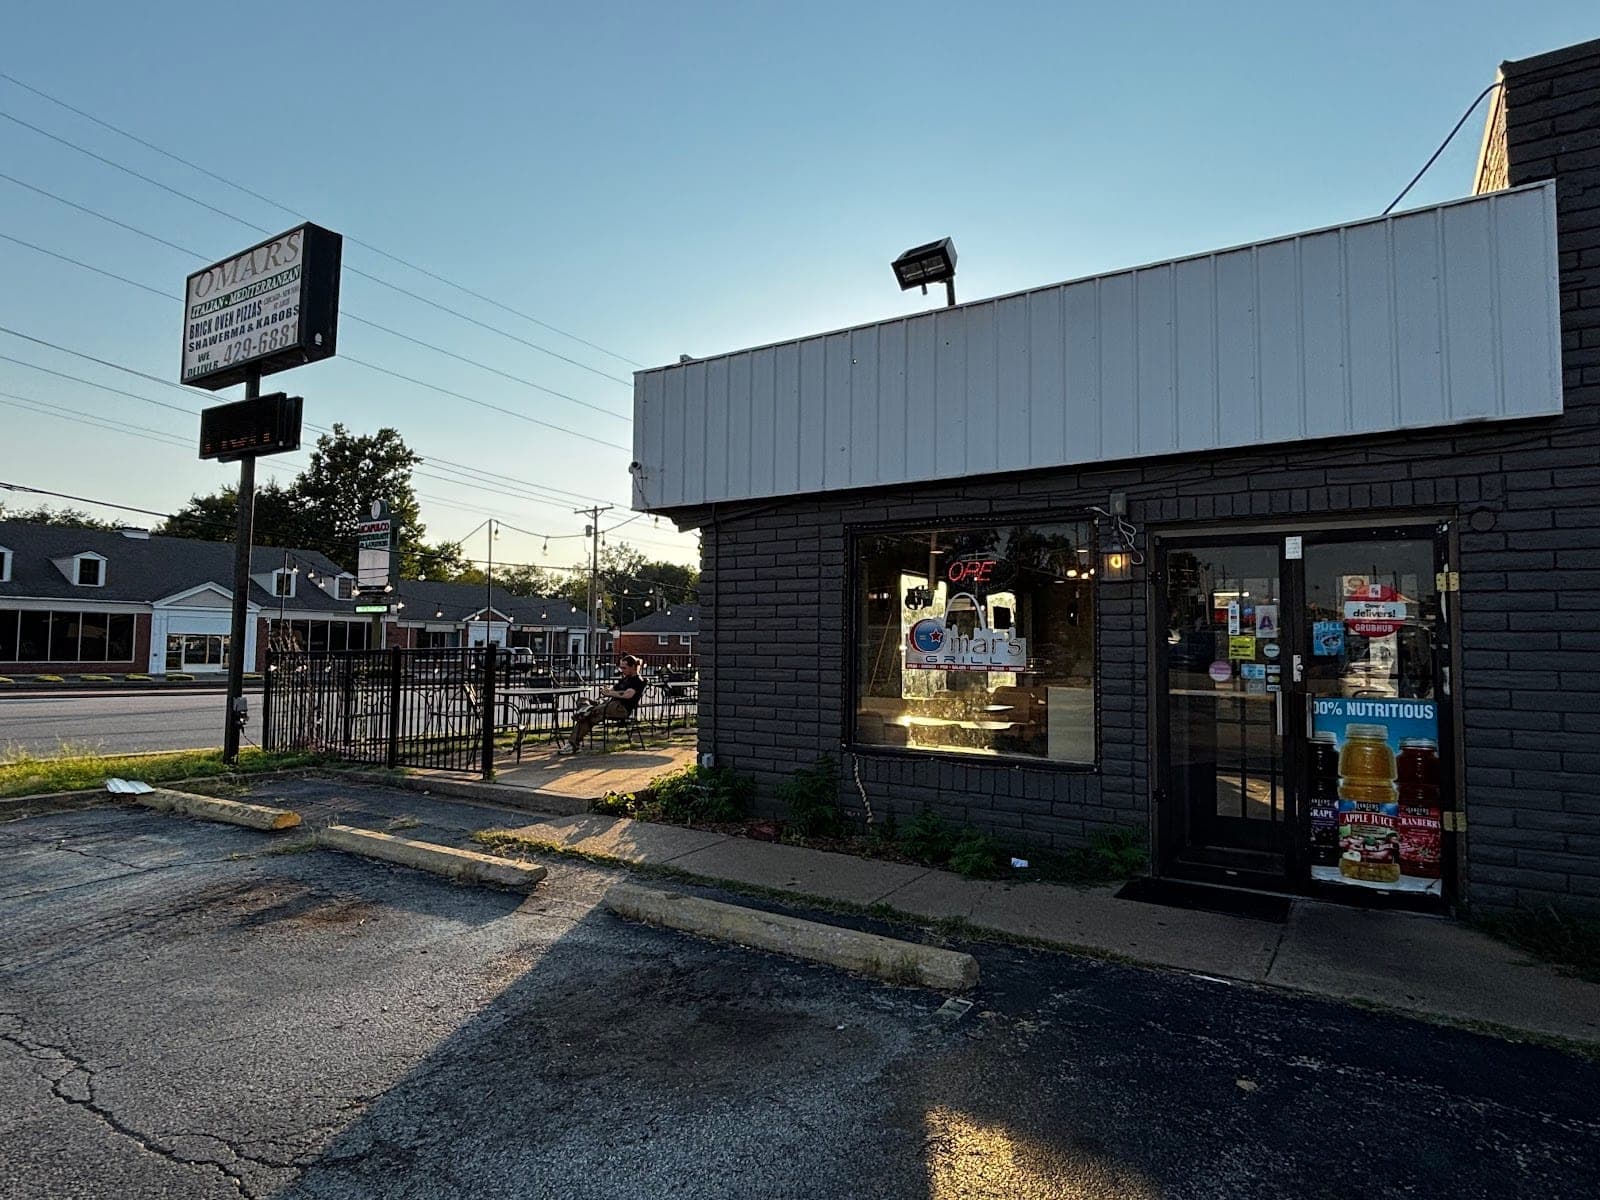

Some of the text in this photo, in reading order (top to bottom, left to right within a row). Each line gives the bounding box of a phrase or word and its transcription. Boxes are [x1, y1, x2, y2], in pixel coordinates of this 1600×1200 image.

[195, 231, 301, 298] OMARS
[192, 267, 300, 318] ITALIAN MEDITERRANEAN
[188, 304, 299, 352] SHAWERMA & KABOBS
[189, 300, 262, 340] BRICK OVEN PIZZAS
[197, 350, 210, 363] WE
[1353, 609, 1396, 618] delivers!
[1355, 623, 1393, 633] GRUBHUB
[925, 655, 1002, 665] GRILL
[1313, 701, 1434, 719] 00% NUTRITIOUS
[1344, 813, 1369, 824] APPLE
[1371, 815, 1394, 827] JUICE
